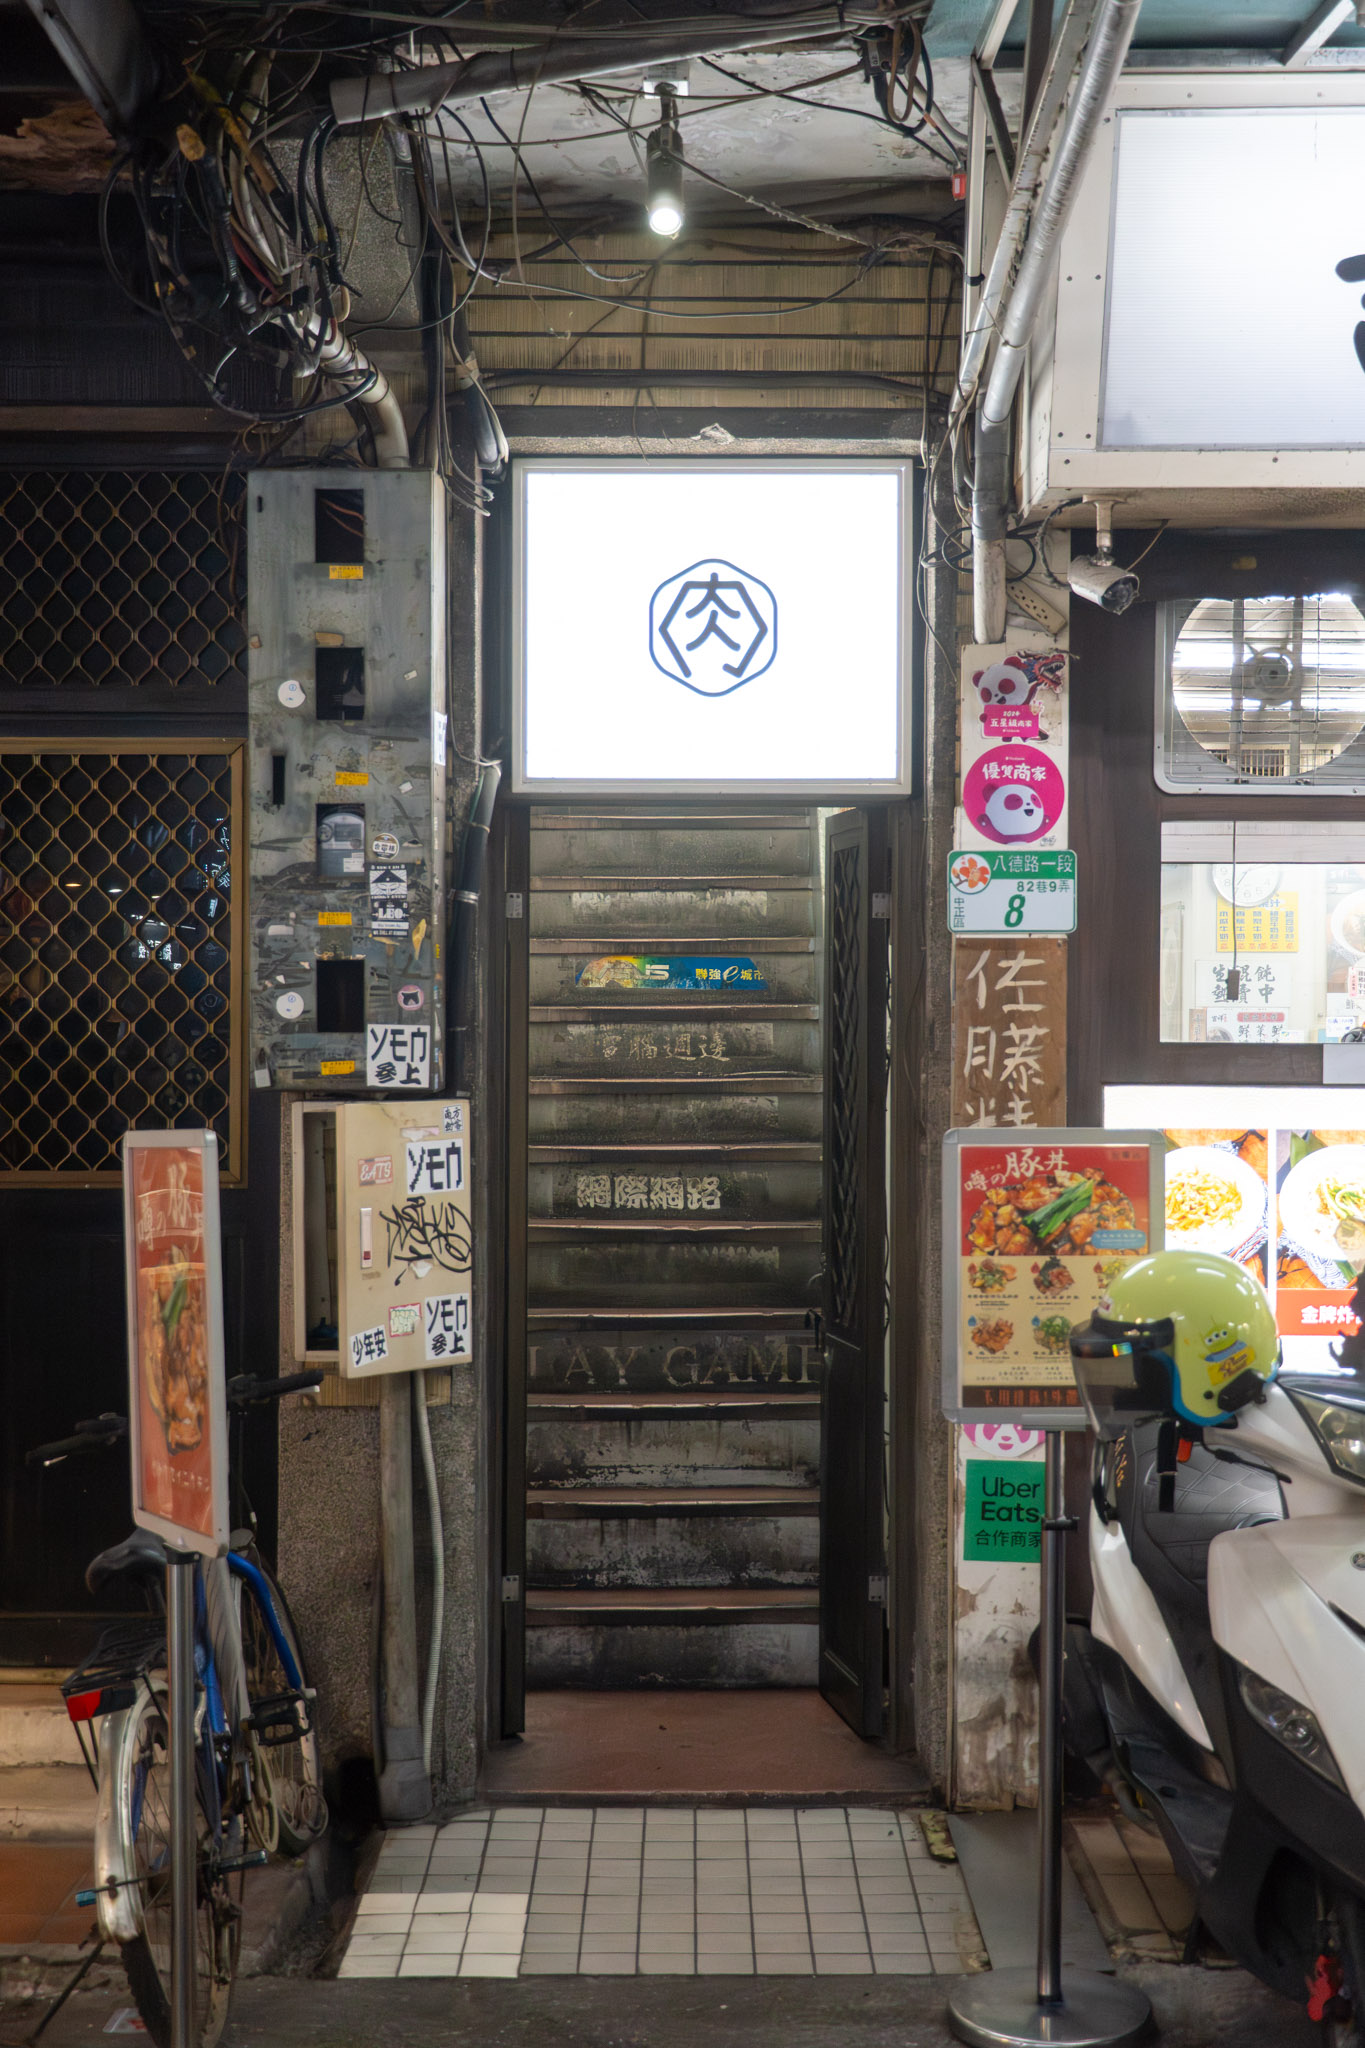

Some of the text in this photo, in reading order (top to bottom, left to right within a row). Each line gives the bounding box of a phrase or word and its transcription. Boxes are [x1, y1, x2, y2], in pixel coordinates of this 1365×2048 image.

[990, 718, 1032, 728] 五星級商家
[982, 762, 1047, 782] 優質商家
[993, 855, 1073, 873] 八德路一段
[1017, 880, 1070, 893] 82巷9弄
[953, 897, 965, 928] 中正區
[1004, 894, 1026, 928] 8
[360, 1161, 392, 1181] EATS
[576, 1174, 722, 1211] 網際網路
[1301, 1305, 1363, 1325] 金牌炸
[982, 1476, 1041, 1498] Uber
[981, 1501, 1041, 1523] Eats
[975, 1529, 1042, 1548] 合作商家
